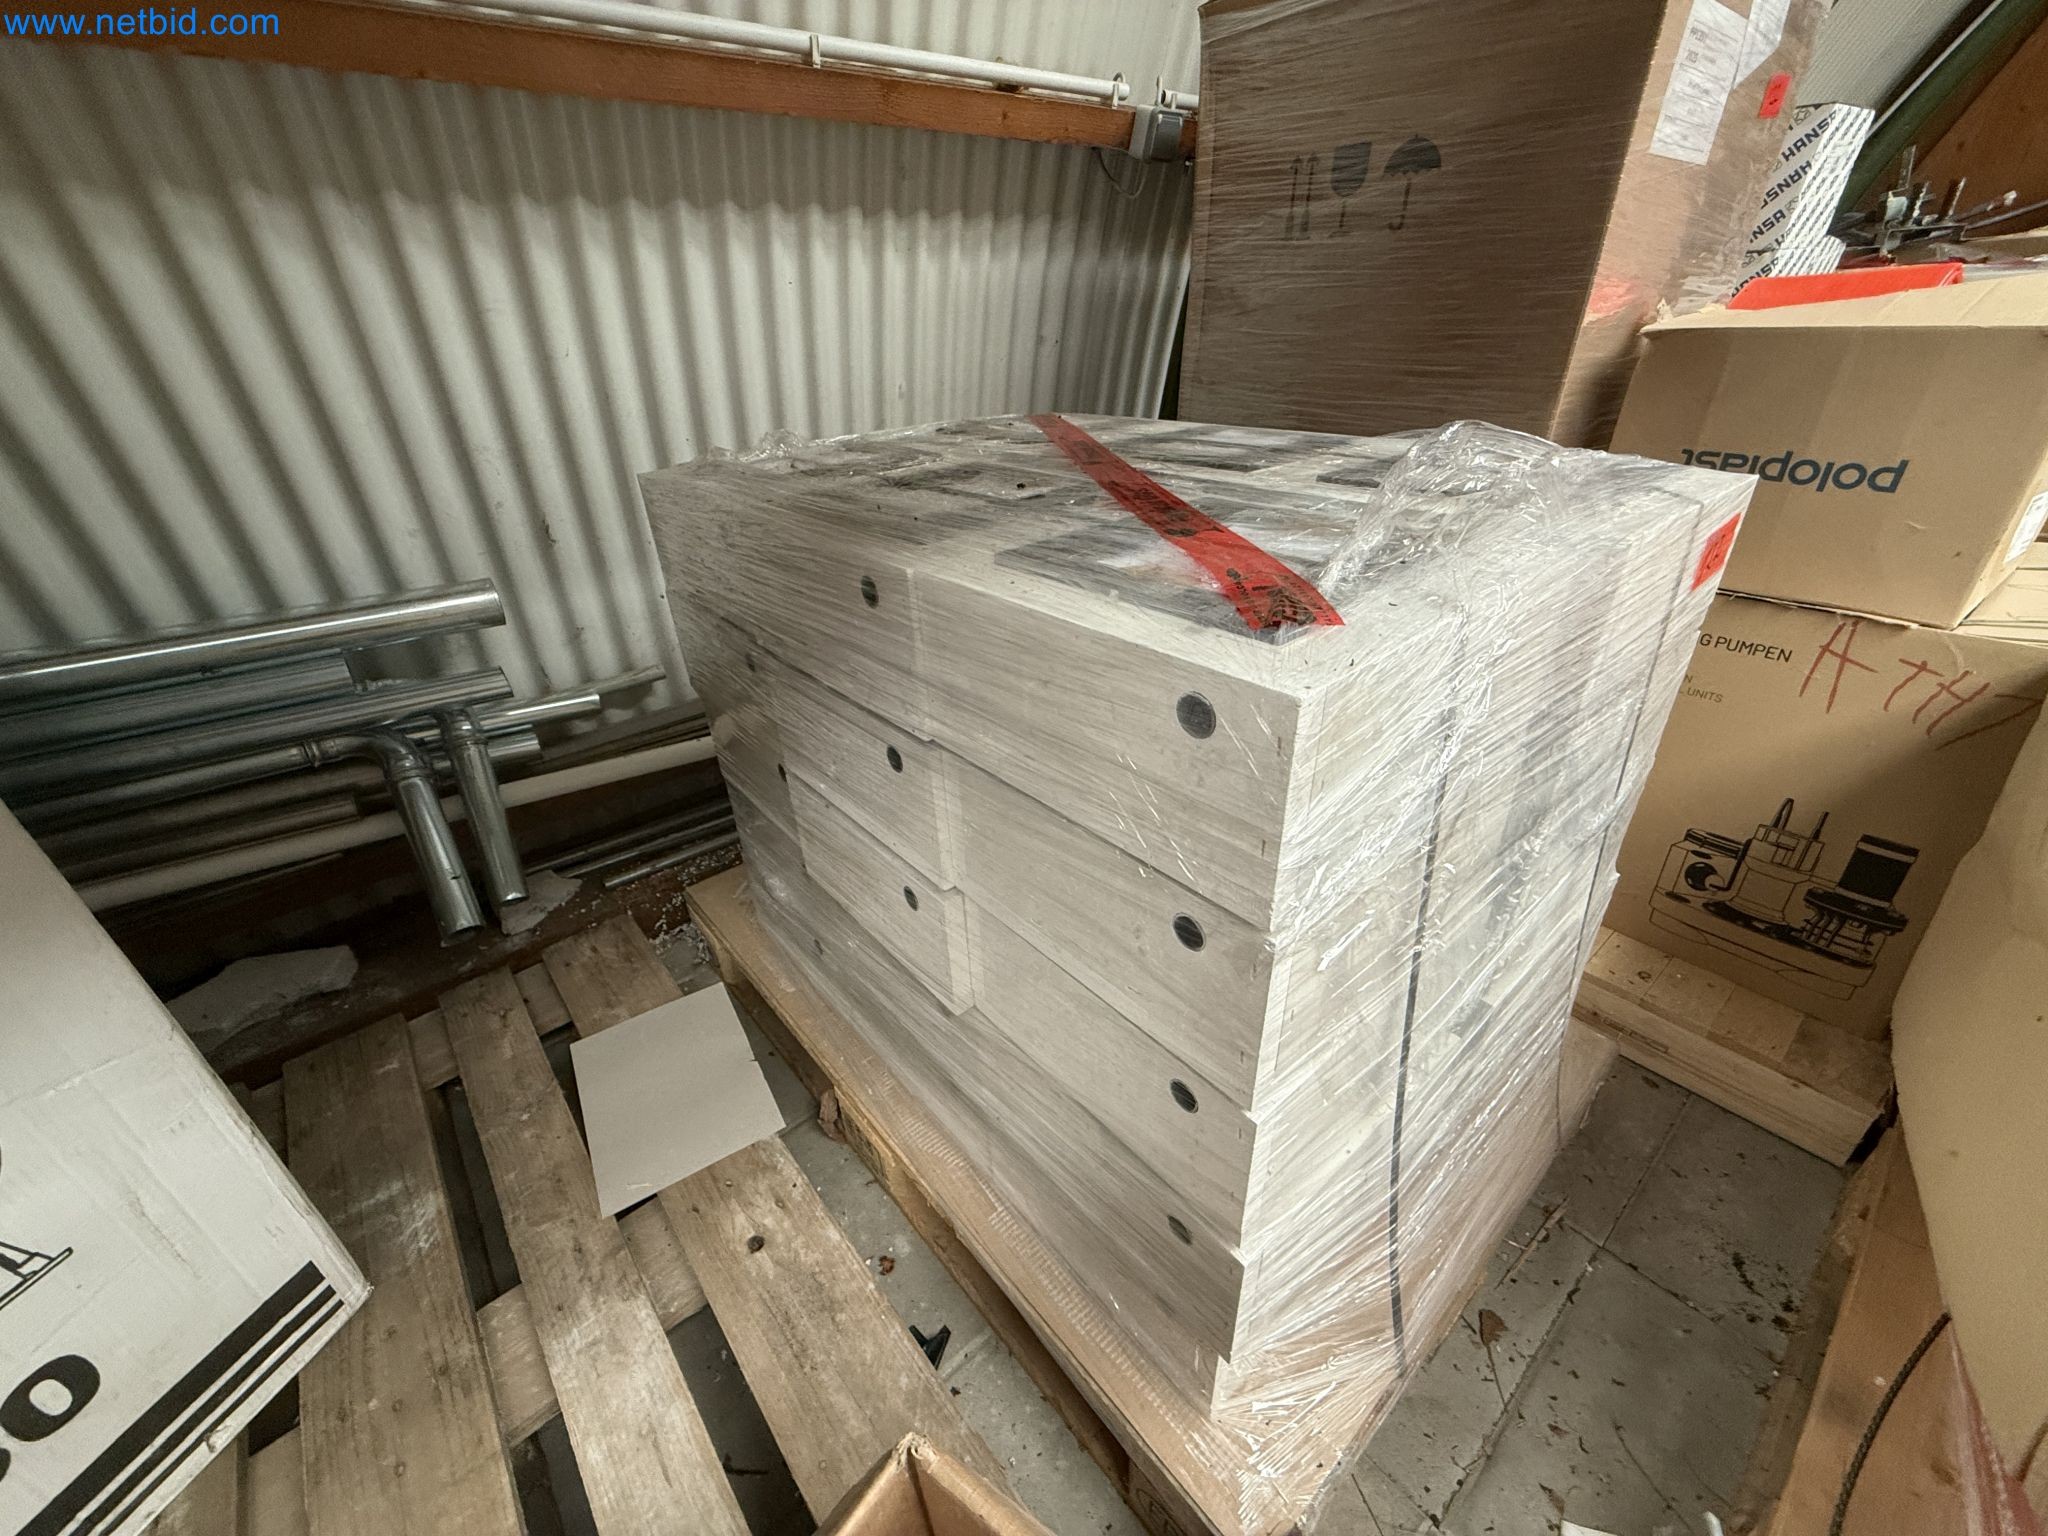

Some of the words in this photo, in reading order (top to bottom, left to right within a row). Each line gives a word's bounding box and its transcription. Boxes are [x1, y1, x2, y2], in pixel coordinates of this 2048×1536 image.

[1749, 209, 1787, 243] NSA
[1714, 635, 1793, 662] PUMPEN
[1687, 688, 1724, 703] UNITS
